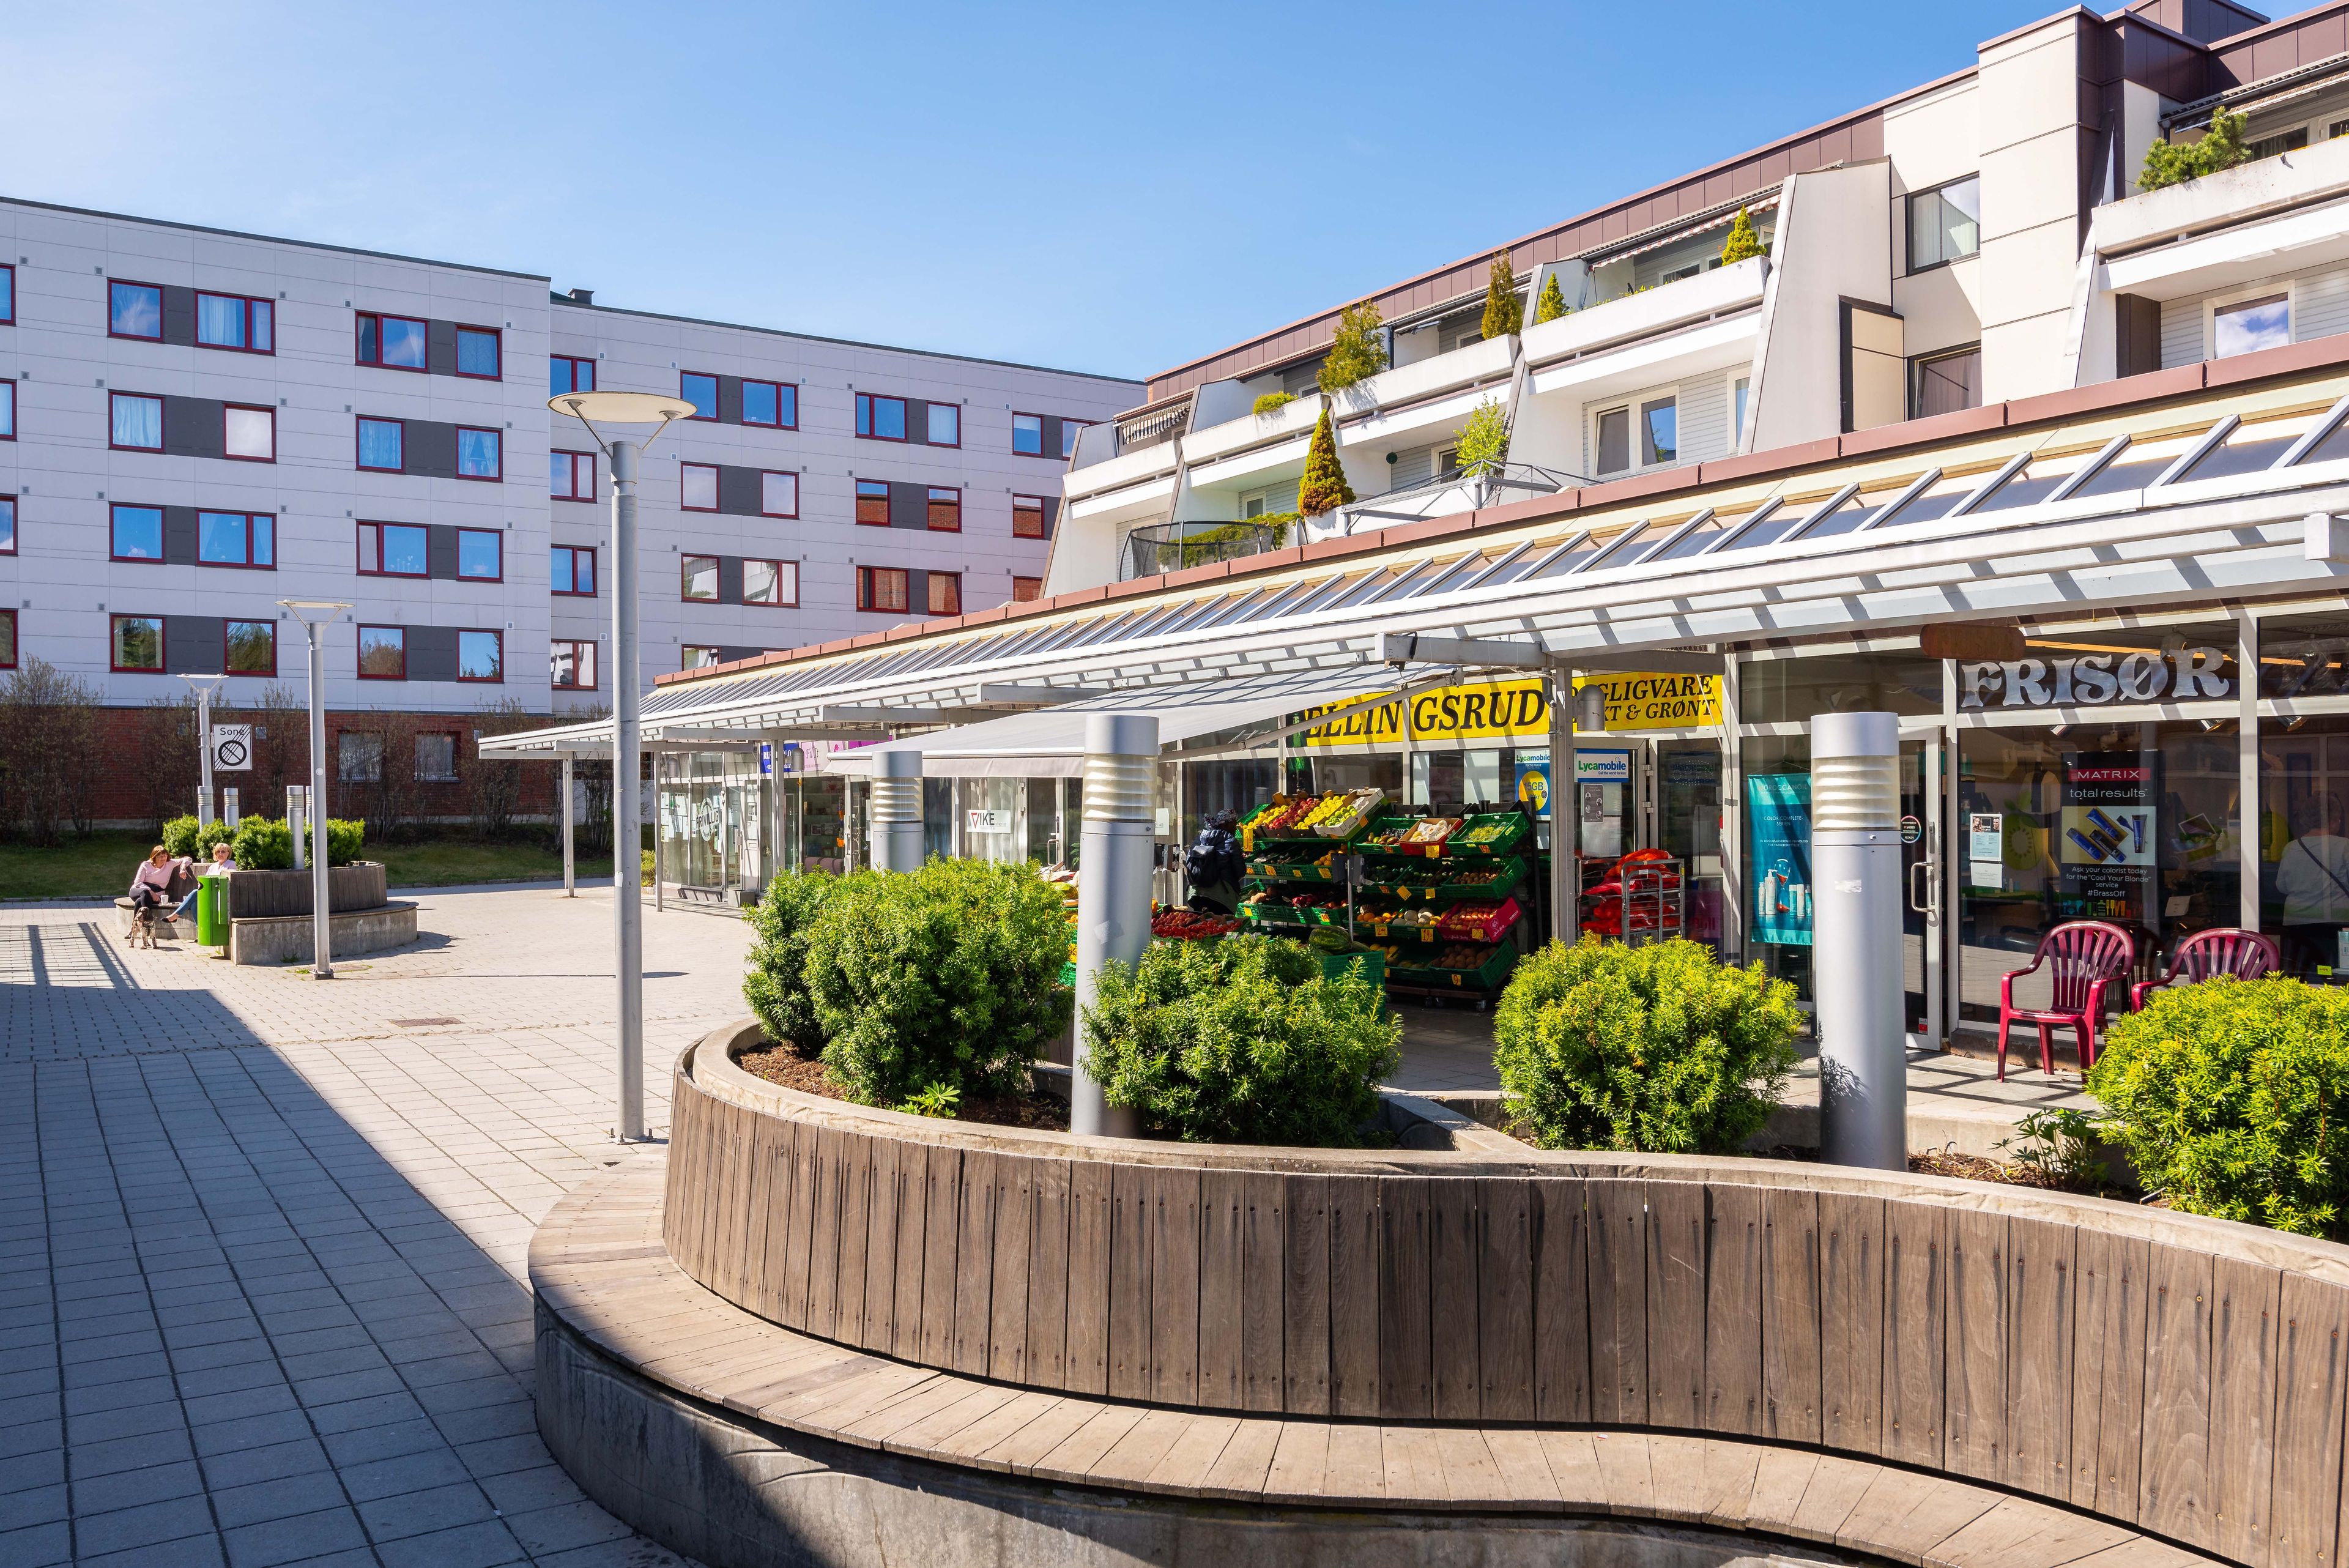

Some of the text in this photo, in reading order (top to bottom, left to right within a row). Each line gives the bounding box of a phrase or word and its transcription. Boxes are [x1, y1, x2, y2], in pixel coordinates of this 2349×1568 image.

[1961, 646, 2230, 708] FRISØR
[1305, 688, 1545, 738] ELLINGSRUD
[1625, 704, 1641, 720] &
[1646, 699, 1715, 719] GRØNT
[1516, 754, 1550, 762] Lycamobile
[1578, 760, 1626, 773] Lycamobile
[2077, 770, 2140, 779] MATRIX
[2069, 788, 2098, 798] total
[971, 812, 995, 829] VIKE
